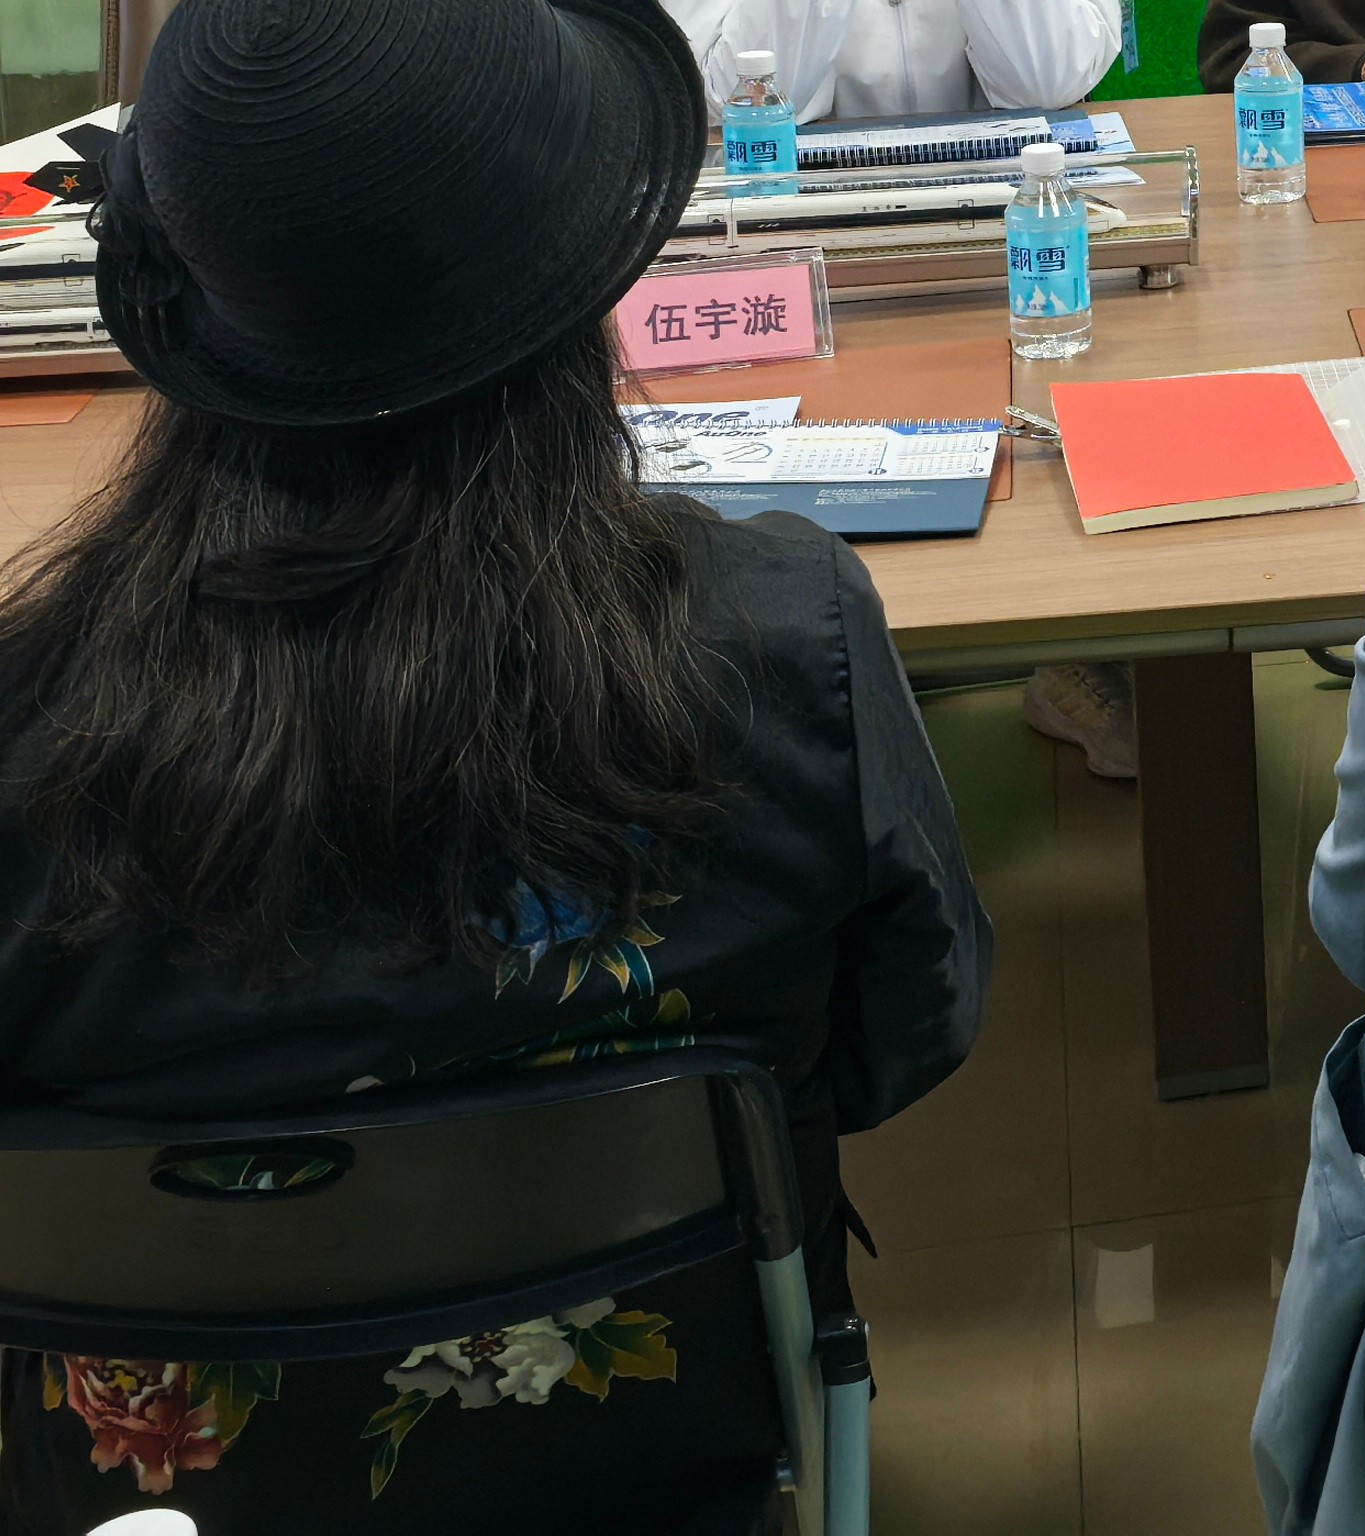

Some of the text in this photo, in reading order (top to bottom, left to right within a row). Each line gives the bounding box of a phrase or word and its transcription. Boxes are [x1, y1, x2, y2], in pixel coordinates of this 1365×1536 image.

[1010, 246, 1066, 272] 飘雪
[645, 293, 788, 345] 伍宇漩
